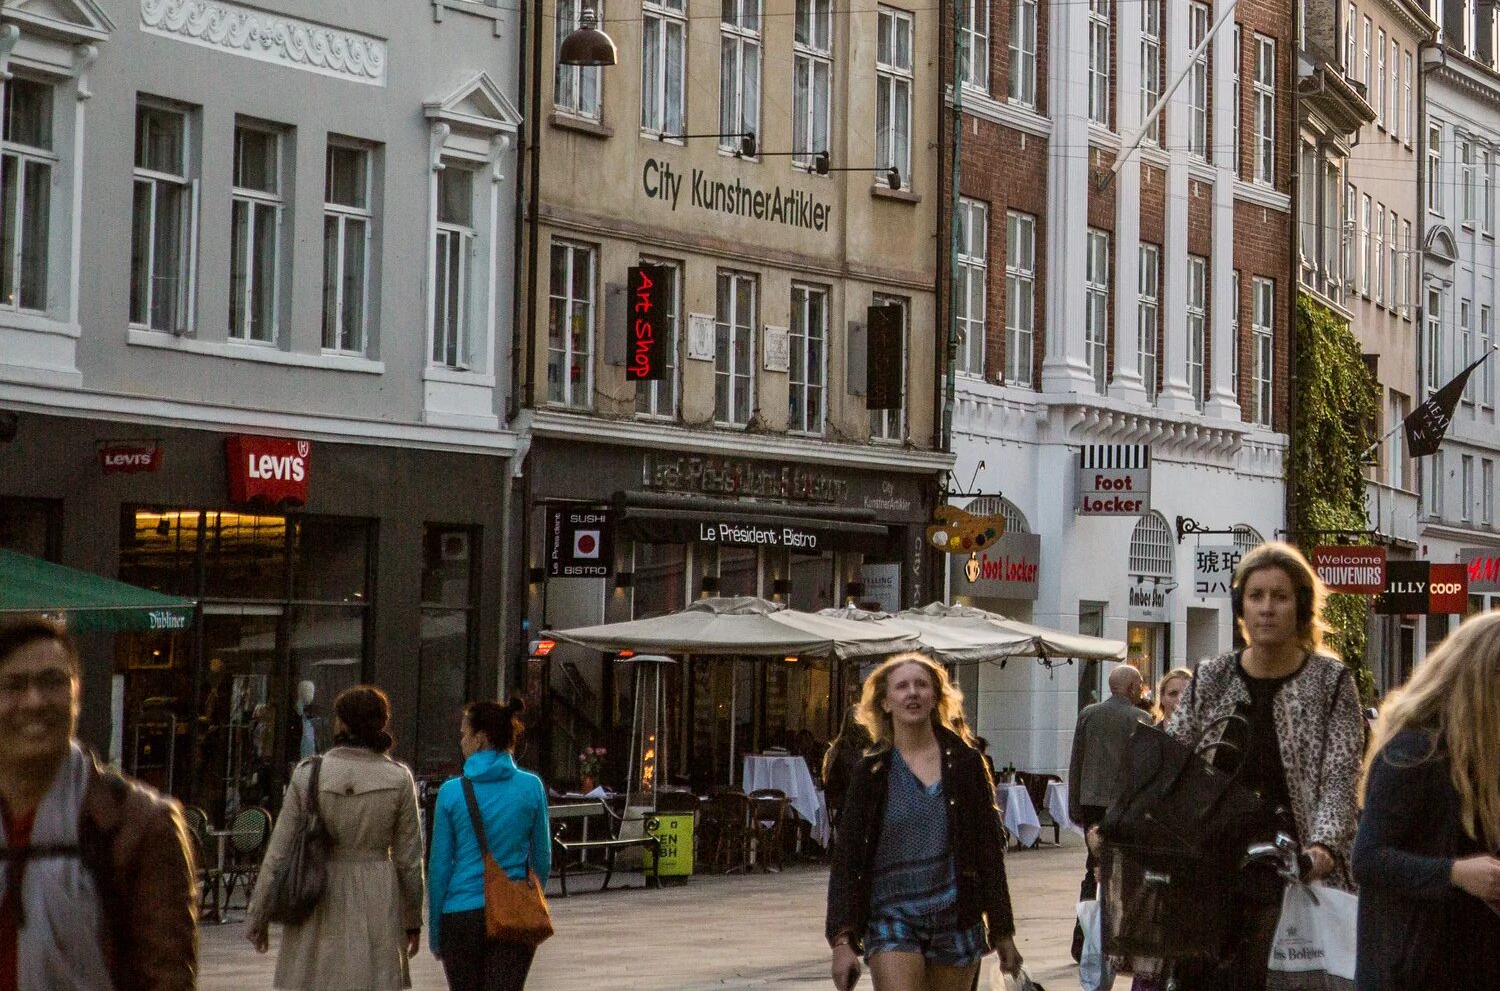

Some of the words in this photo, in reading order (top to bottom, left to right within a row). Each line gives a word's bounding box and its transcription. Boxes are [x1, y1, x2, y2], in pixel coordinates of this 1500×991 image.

[642, 158, 682, 211] City
[691, 168, 831, 232] KunstnerArtikler
[635, 271, 654, 313] Art
[627, 319, 656, 377] Shop
[1095, 475, 1133, 491] Foot
[1083, 496, 1143, 512] Locker
[570, 514, 607, 524] SUSHI
[700, 523, 716, 541] Le
[720, 524, 777, 545] Président
[783, 528, 817, 548] Bistro
[1317, 554, 1381, 565] Welcome
[564, 566, 607, 576] BISTRO
[1005, 555, 1039, 583] Locker
[1317, 566, 1381, 586] SOUVENIRS
[1383, 582, 1427, 594] ILLY
[1429, 583, 1462, 595] COOP
[660, 834, 678, 844] EN
